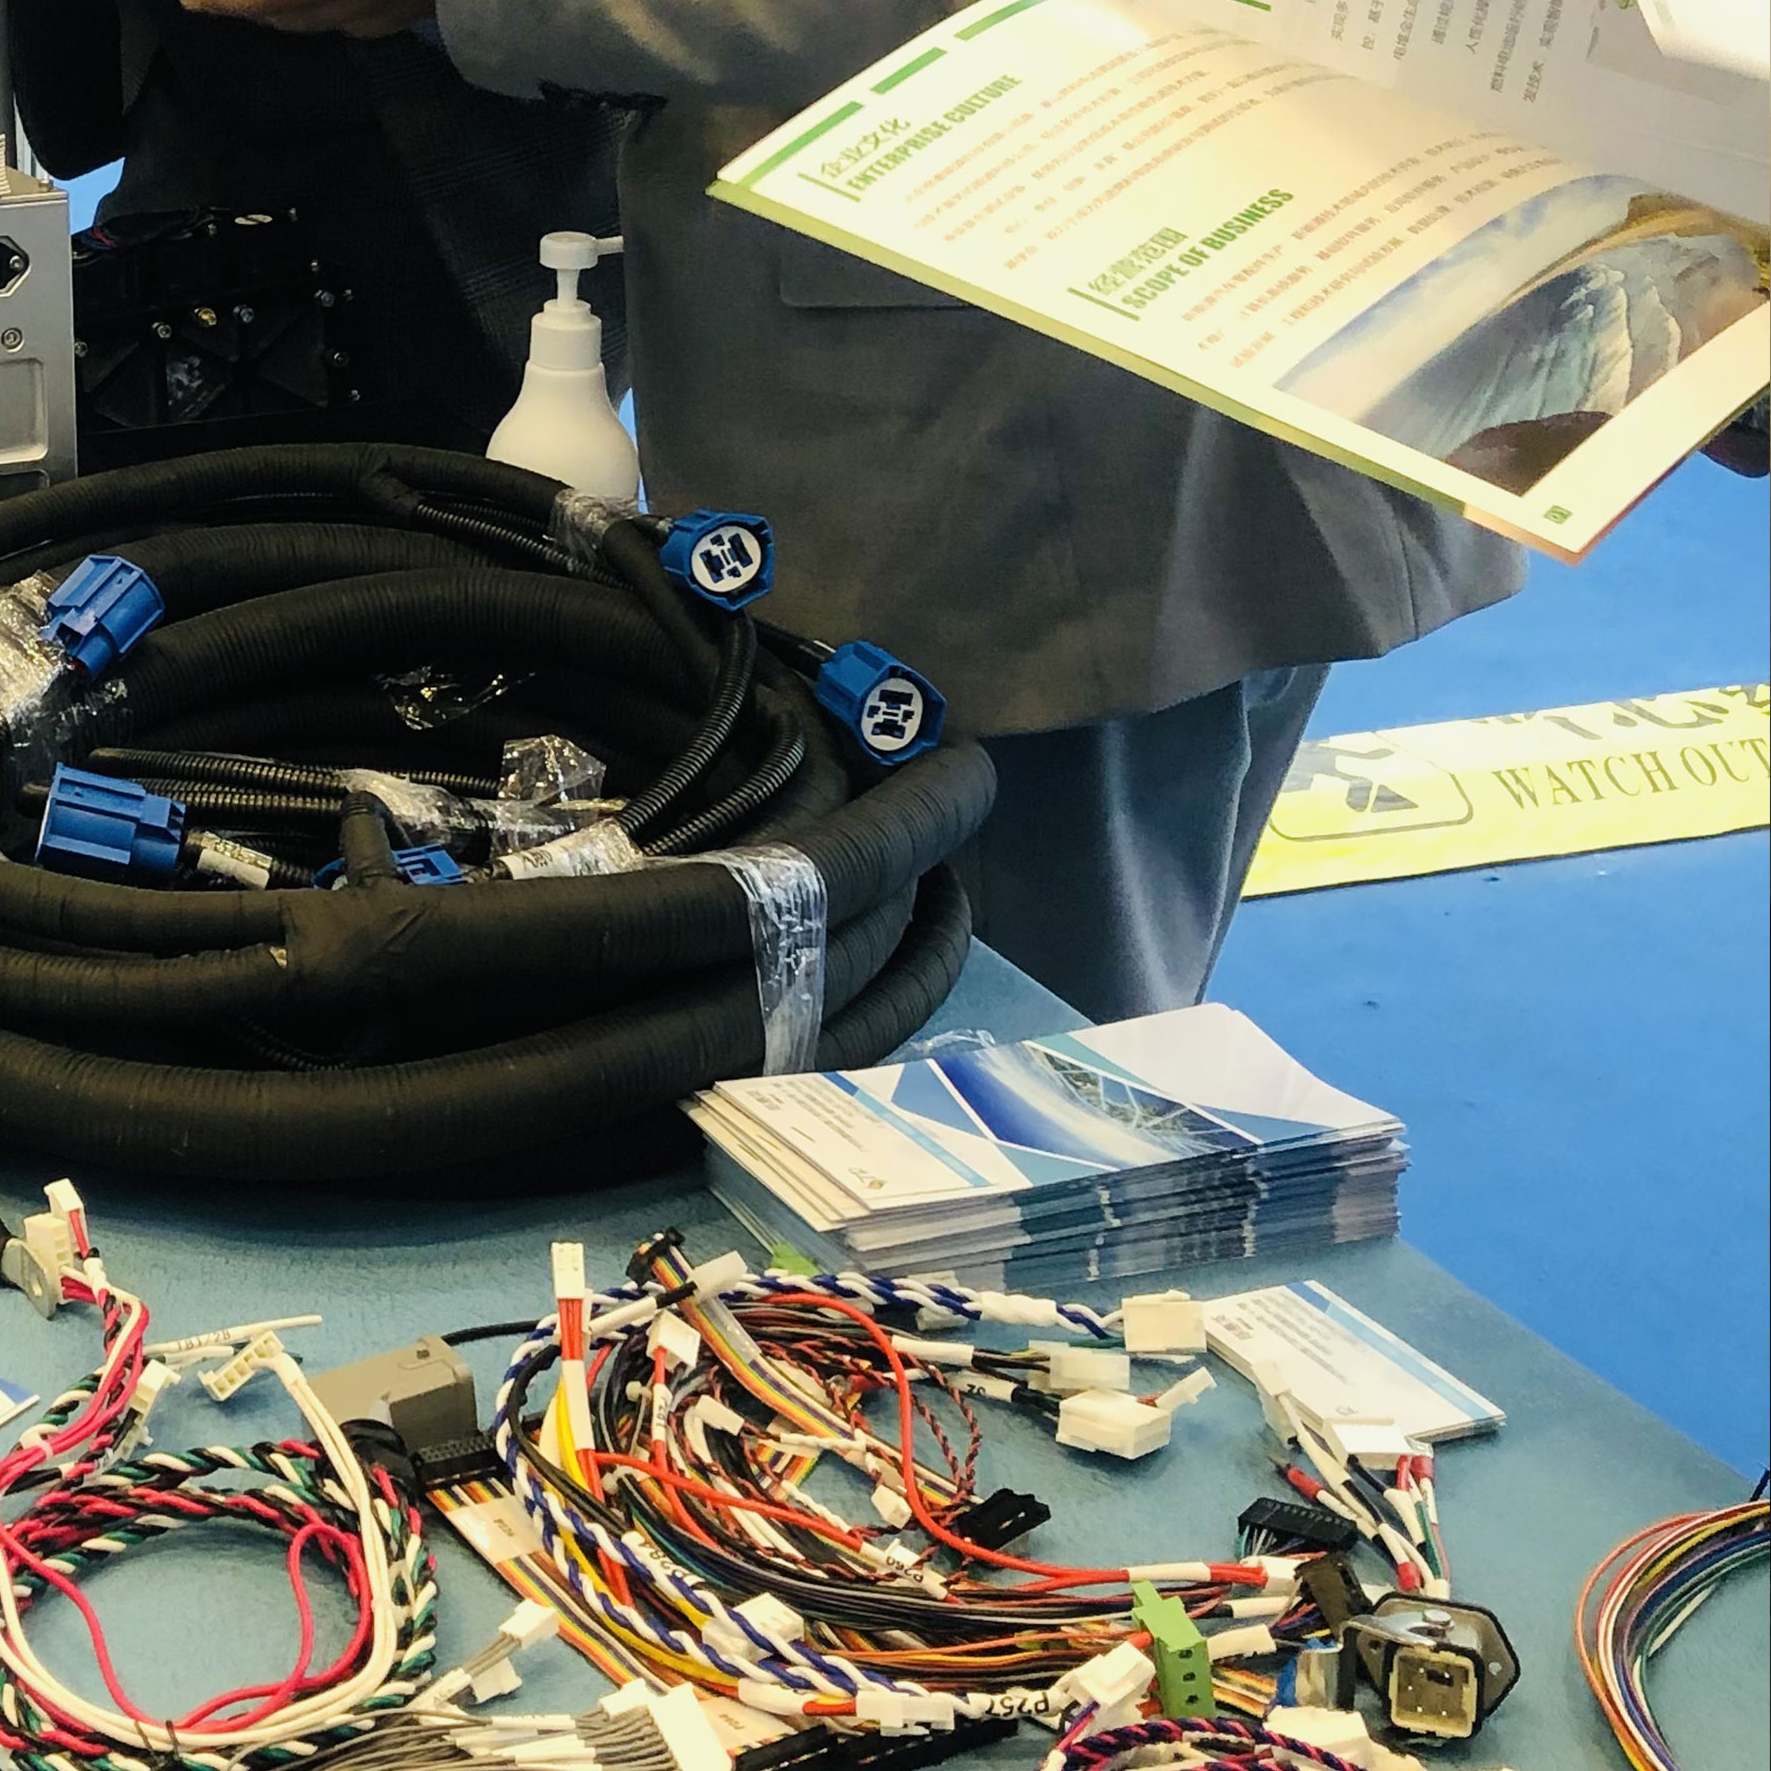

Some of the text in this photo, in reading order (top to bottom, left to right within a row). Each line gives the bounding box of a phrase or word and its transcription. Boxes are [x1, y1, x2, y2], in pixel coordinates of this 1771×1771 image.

[821, 118, 911, 177] 企业文化
[847, 75, 1022, 191] ENTERPRISE CULTURE
[1122, 188, 1293, 309] SCOPE OF BUSINESS
[1491, 737, 1770, 809] WATCH OUT
[885, 1554, 924, 1584] P260
[986, 1690, 1050, 1717] P257
